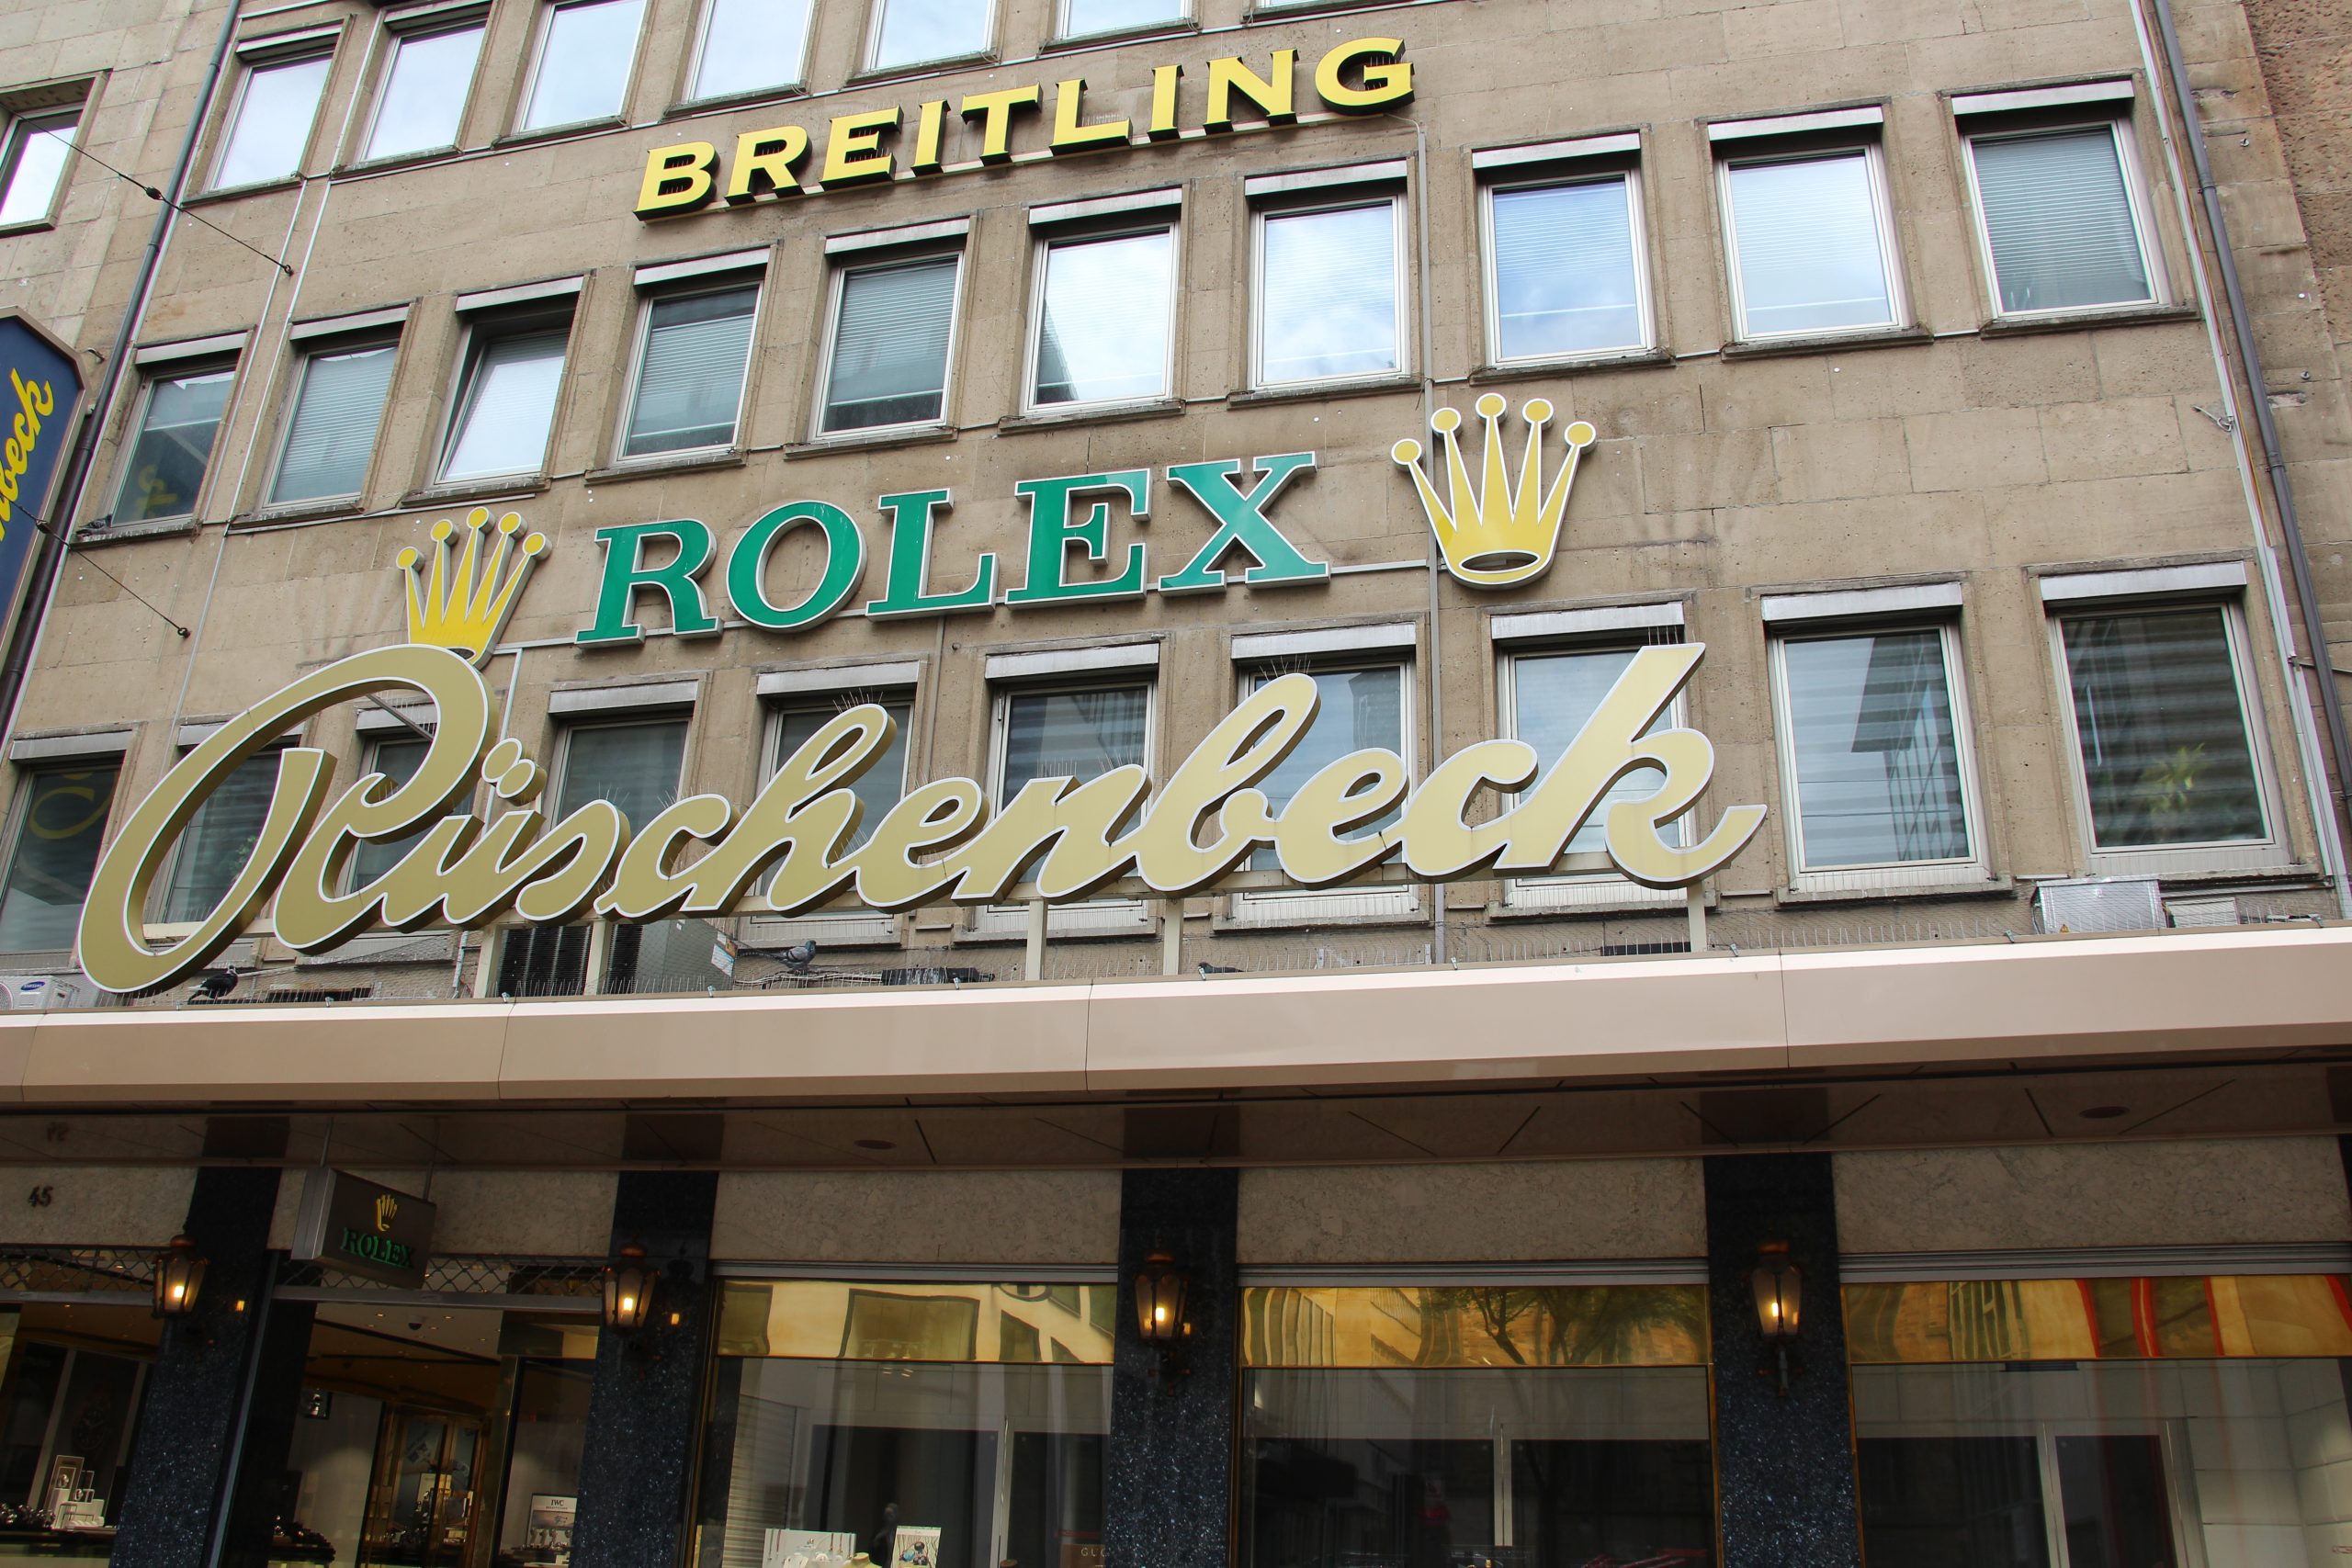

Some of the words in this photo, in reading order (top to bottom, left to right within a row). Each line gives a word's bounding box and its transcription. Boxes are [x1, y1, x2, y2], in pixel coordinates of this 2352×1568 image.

[634, 37, 1415, 219] BREITLING
[575, 451, 1329, 649] ROLEX
[77, 642, 1768, 994] Rüschenbeck
[28, 1186, 53, 1208] 45
[340, 1227, 416, 1269] ROLEX
